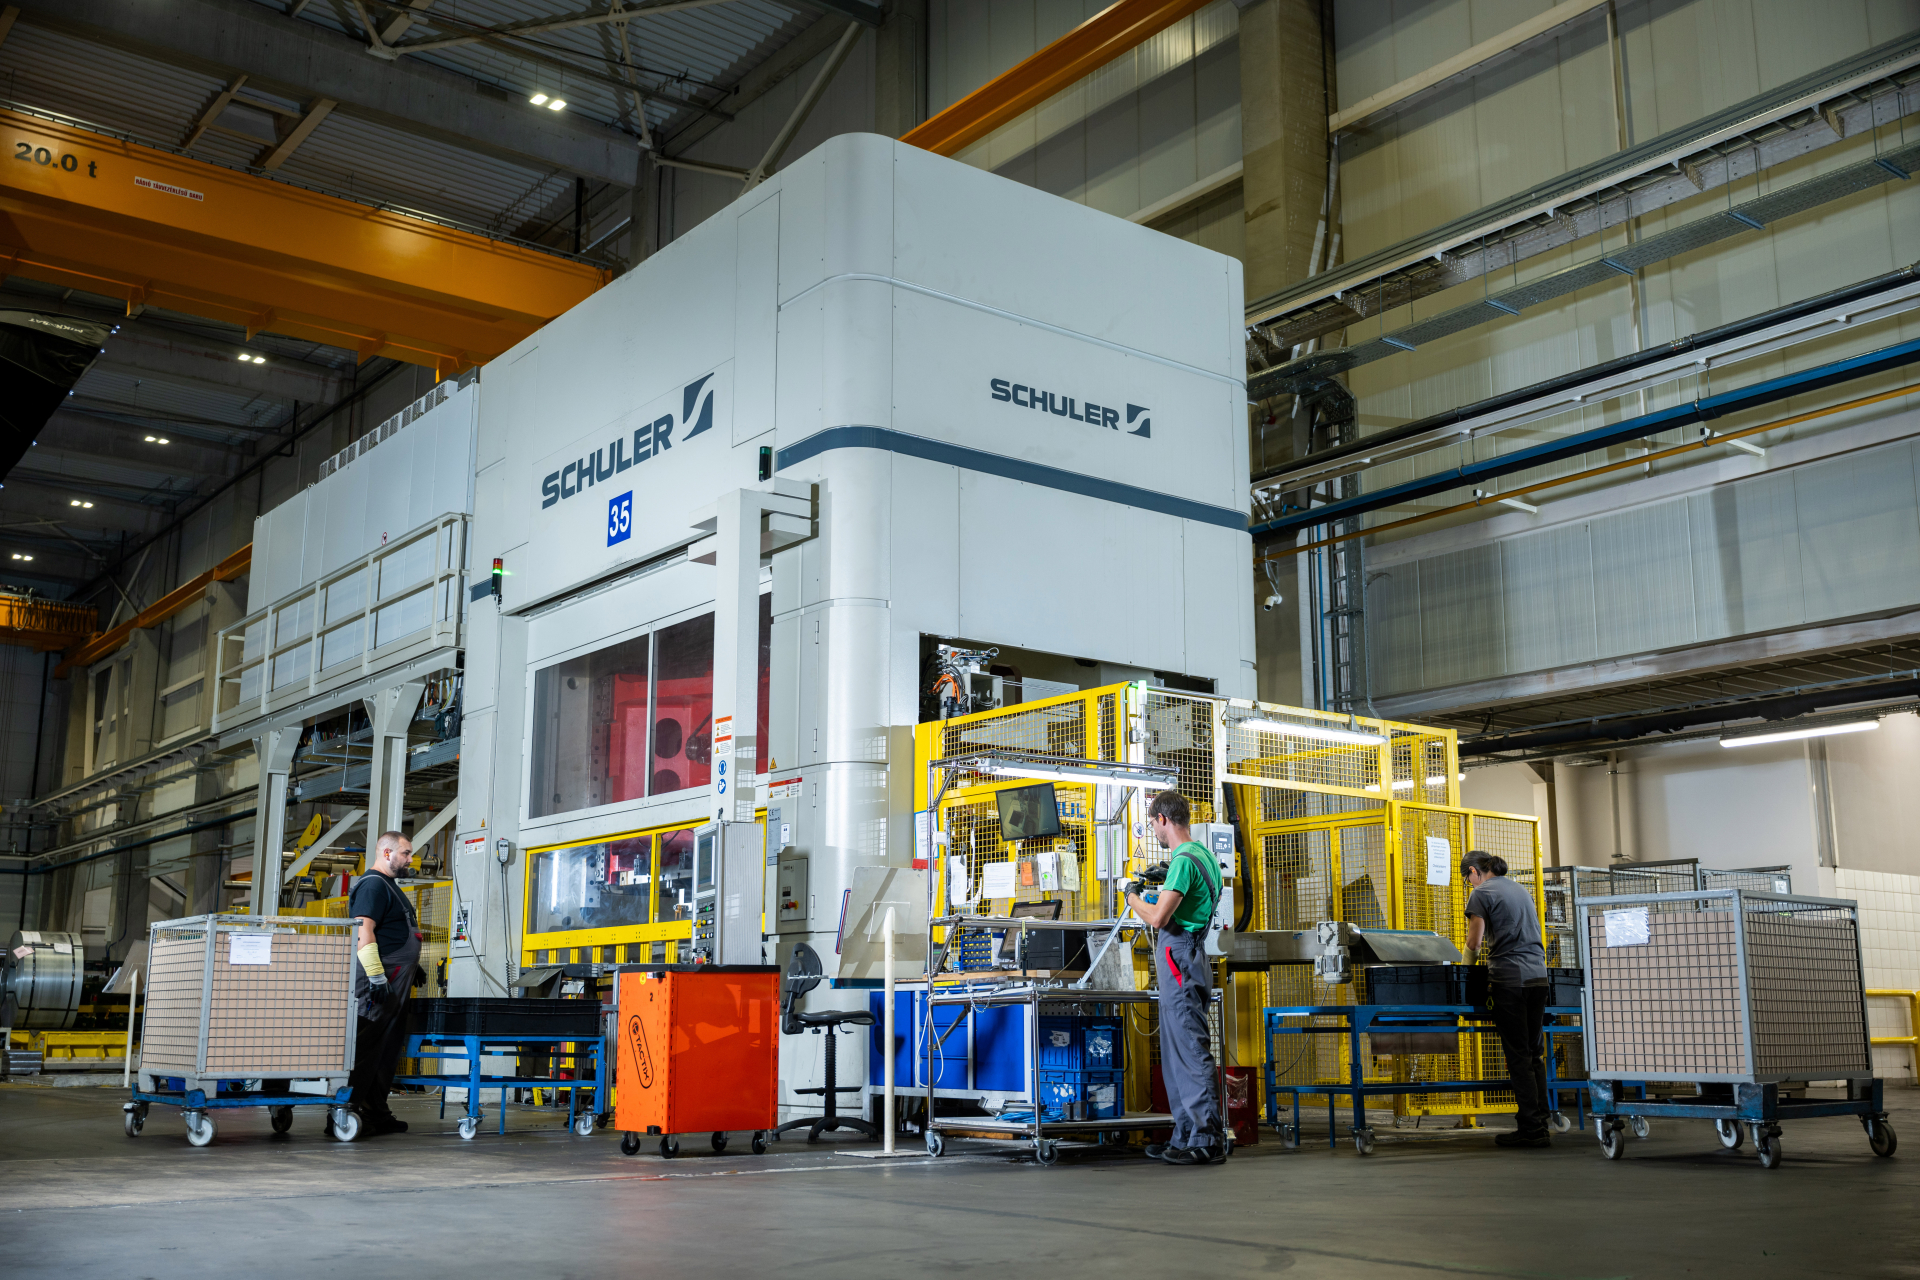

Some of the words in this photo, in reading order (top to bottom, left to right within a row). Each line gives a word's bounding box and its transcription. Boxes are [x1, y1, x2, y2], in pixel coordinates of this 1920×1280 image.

[14, 142, 78, 172] 20.0
[87, 160, 98, 178] t
[990, 377, 1120, 431] SCHULER
[541, 413, 674, 510] SCHULER
[609, 499, 630, 538] 35
[649, 992, 654, 1002] 2
[636, 1034, 650, 1081] TACTIX
